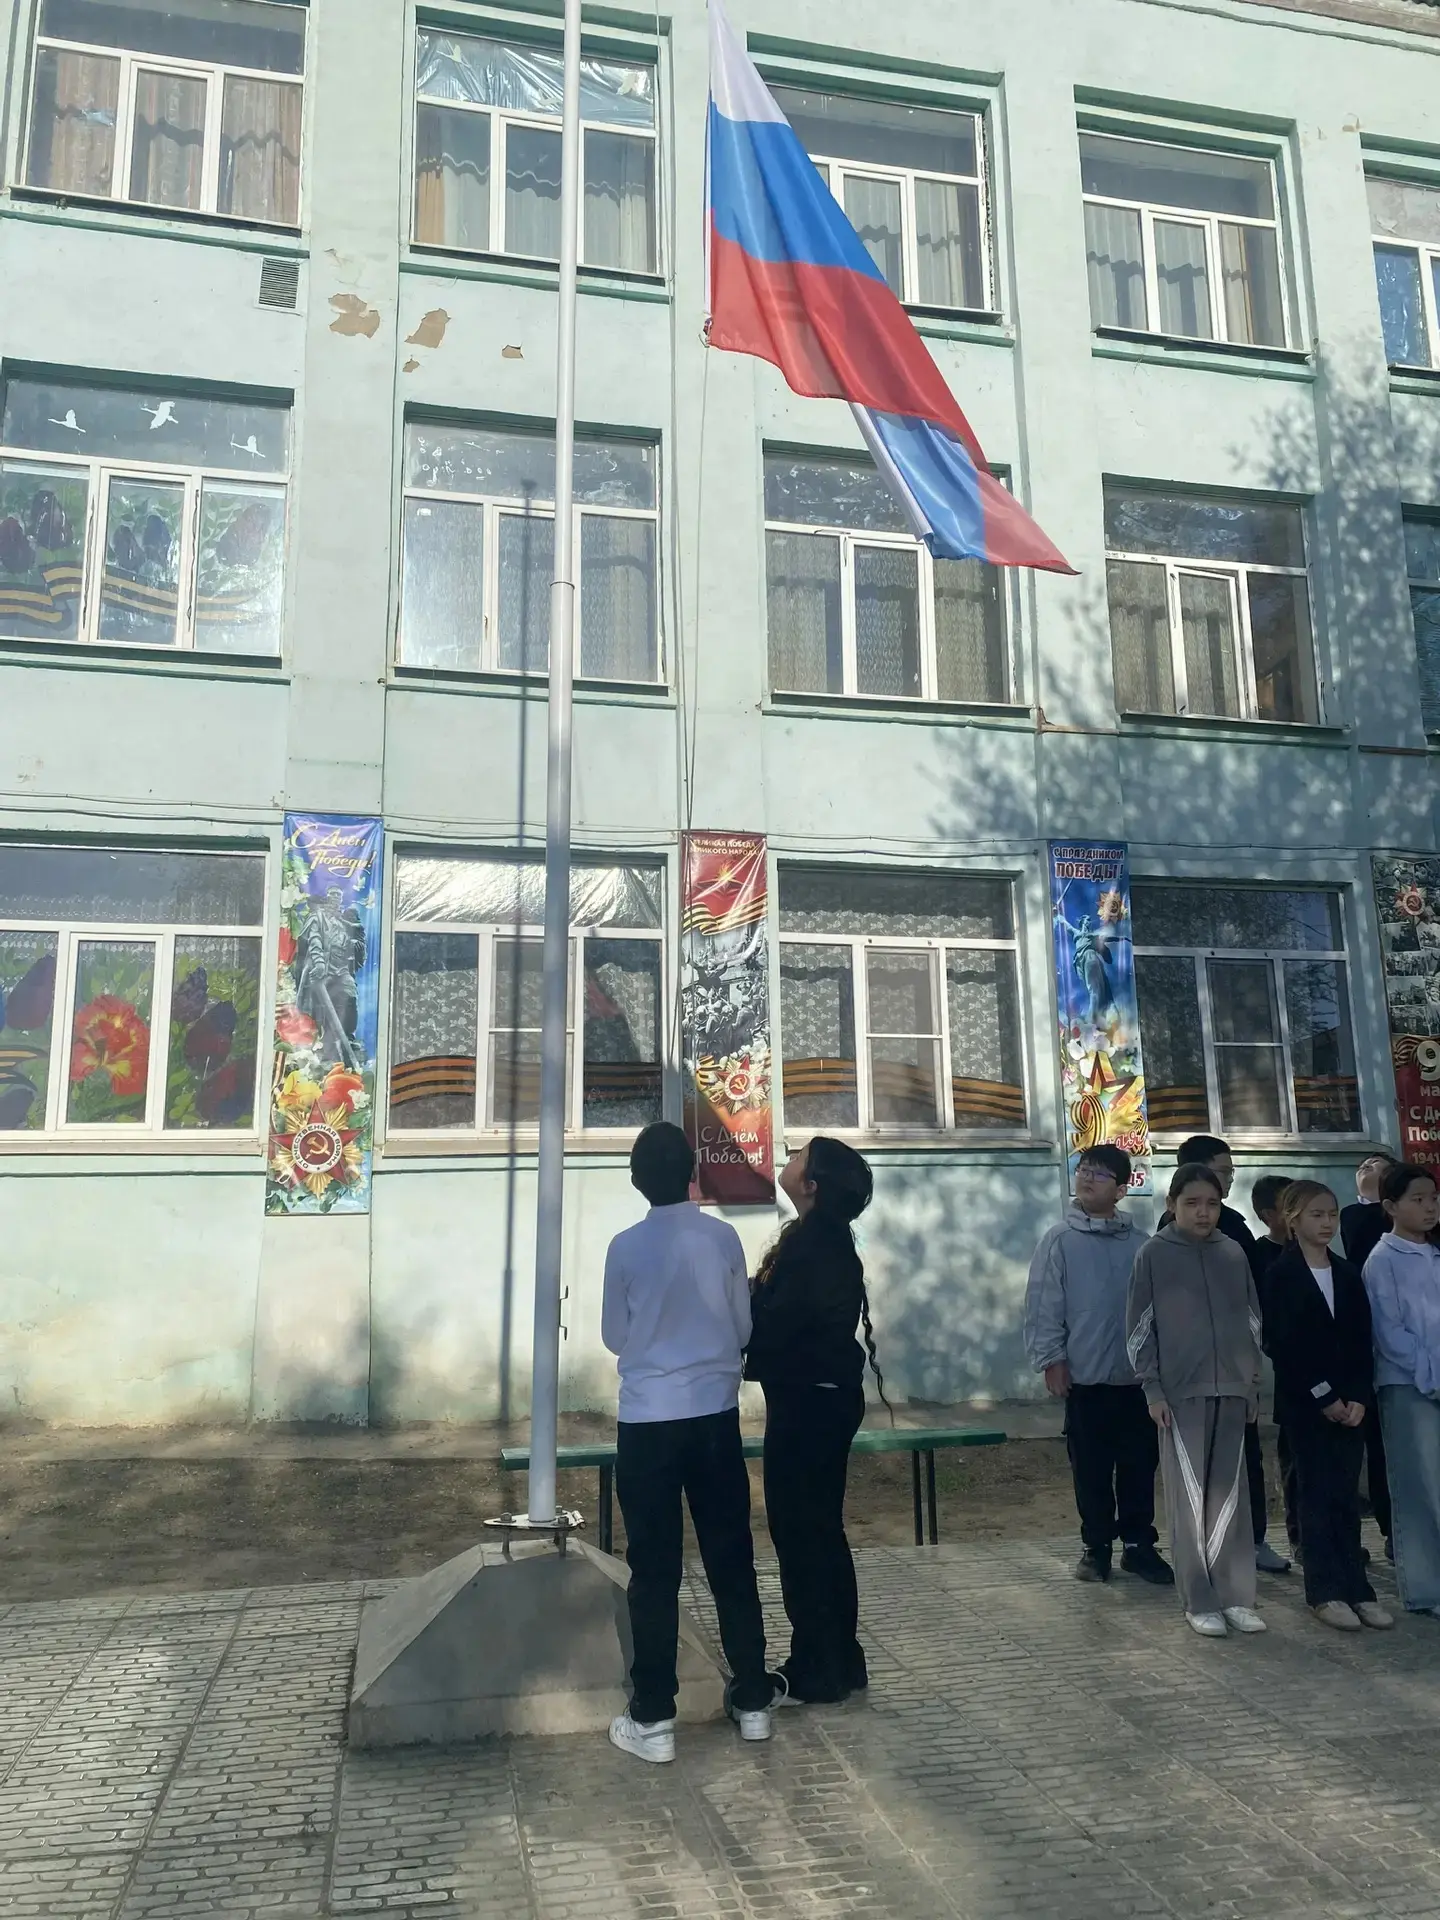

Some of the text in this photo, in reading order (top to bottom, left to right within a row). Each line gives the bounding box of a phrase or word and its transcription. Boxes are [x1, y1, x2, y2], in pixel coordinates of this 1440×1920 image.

[291, 823, 318, 848] С
[308, 849, 377, 878] Победы!
[1053, 847, 1125, 861] С ПРАЗДНИКОМ
[1055, 861, 1124, 882] ПОБЕДЫ!
[1417, 1040, 1440, 1081] 9
[1409, 1106, 1421, 1120] С
[701, 1125, 759, 1144] С Днём
[293, 1124, 337, 1169] ОТЕЧЕСТВЕННАЯ
[694, 1146, 763, 1165] Победы!
